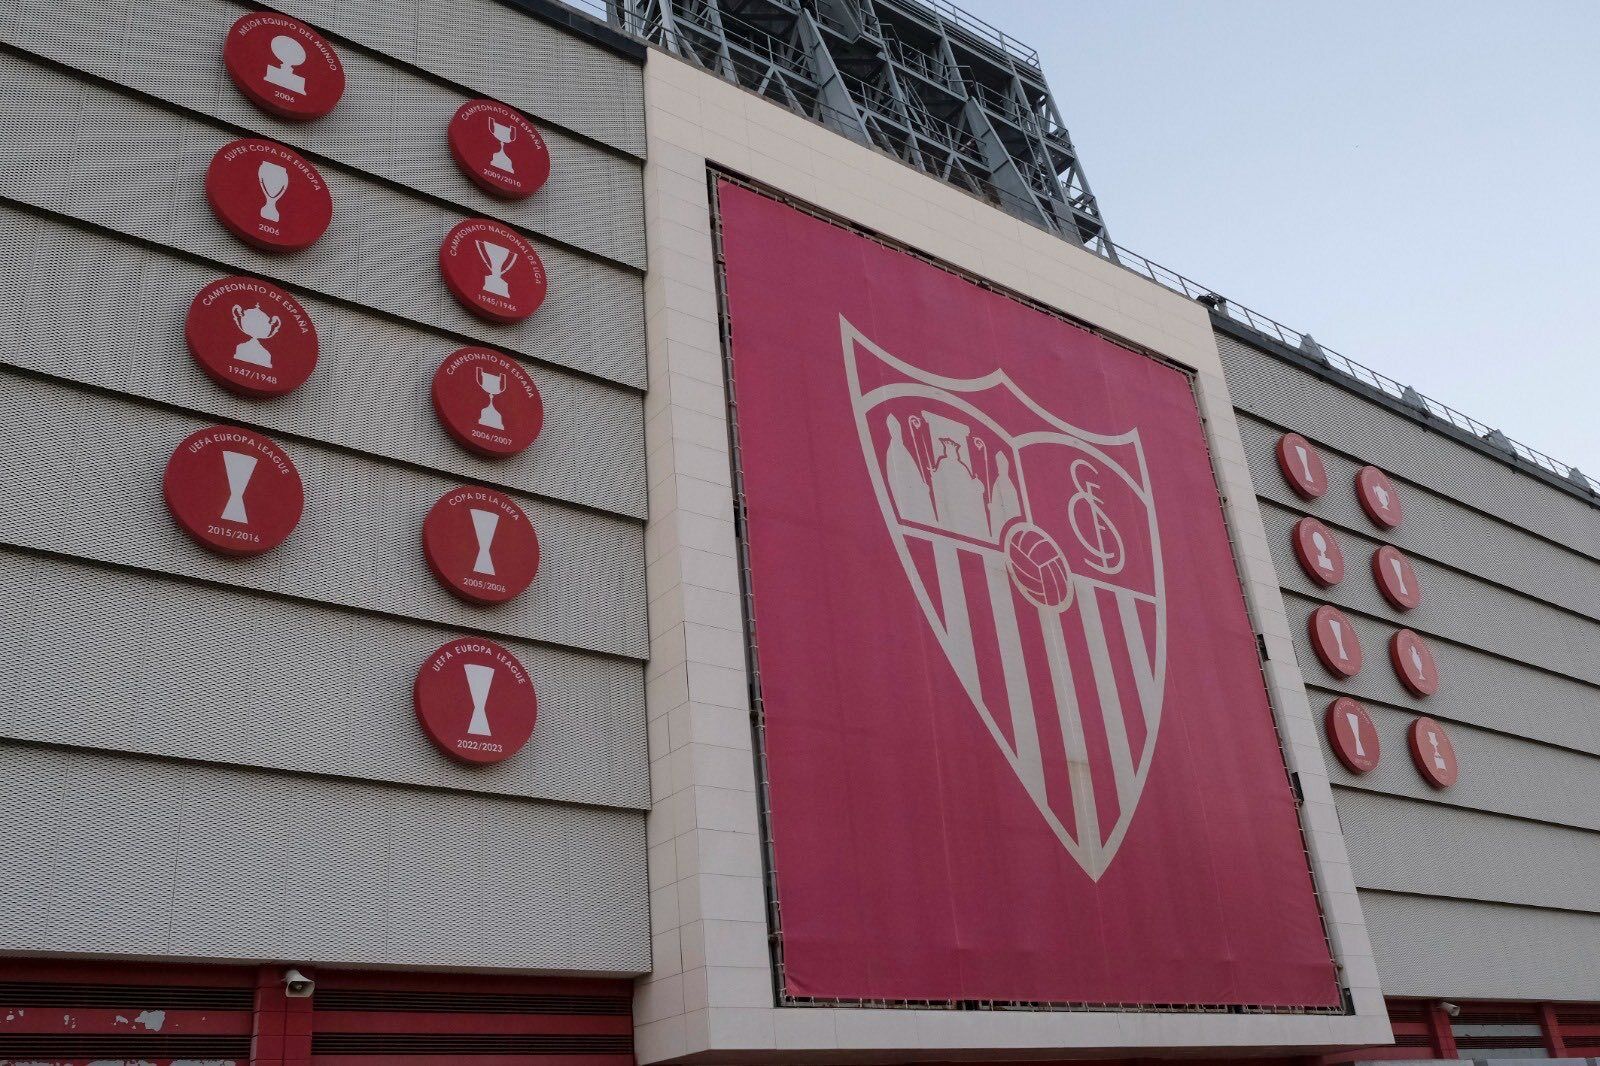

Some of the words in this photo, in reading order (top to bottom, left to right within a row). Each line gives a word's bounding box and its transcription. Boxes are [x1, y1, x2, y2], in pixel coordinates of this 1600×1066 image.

[262, 18, 297, 30] EQUIPO
[299, 28, 314, 41] DEL
[314, 40, 337, 71] MUNDO
[274, 90, 295, 103] 2006
[510, 115, 520, 124] DE
[224, 146, 248, 162] SUPER
[249, 144, 278, 155] COPA
[280, 152, 292, 161] DE
[293, 160, 321, 191] EUROPA
[259, 224, 279, 236] 2006
[450, 224, 486, 256] CAMPEONATO
[488, 225, 528, 254] NACIONAL
[527, 255, 537, 265] DE
[533, 266, 541, 284] LIGA
[202, 283, 267, 306] CAMPEONATO
[269, 291, 281, 302] DE
[282, 301, 308, 334] ESPAÑA
[478, 294, 517, 312] 1945/1946
[447, 353, 497, 375] CAMPEONATO
[499, 360, 510, 370] DE
[228, 366, 277, 384] 1947/1948
[472, 429, 512, 446] 2006/2007
[189, 437, 212, 453] UEFA
[214, 433, 255, 447] EUROPA
[257, 443, 290, 475] LEAGUE
[449, 493, 473, 506] COPA
[475, 492, 486, 500] DE
[489, 495, 498, 505] LA
[501, 502, 520, 521] UEFA
[208, 525, 260, 543] 2015/2016
[463, 577, 506, 592] 2005/2006
[432, 651, 453, 672] UEFA
[455, 644, 492, 655] EUROPA
[496, 652, 526, 685] LEAGUE
[457, 739, 503, 753] 2022/2023
